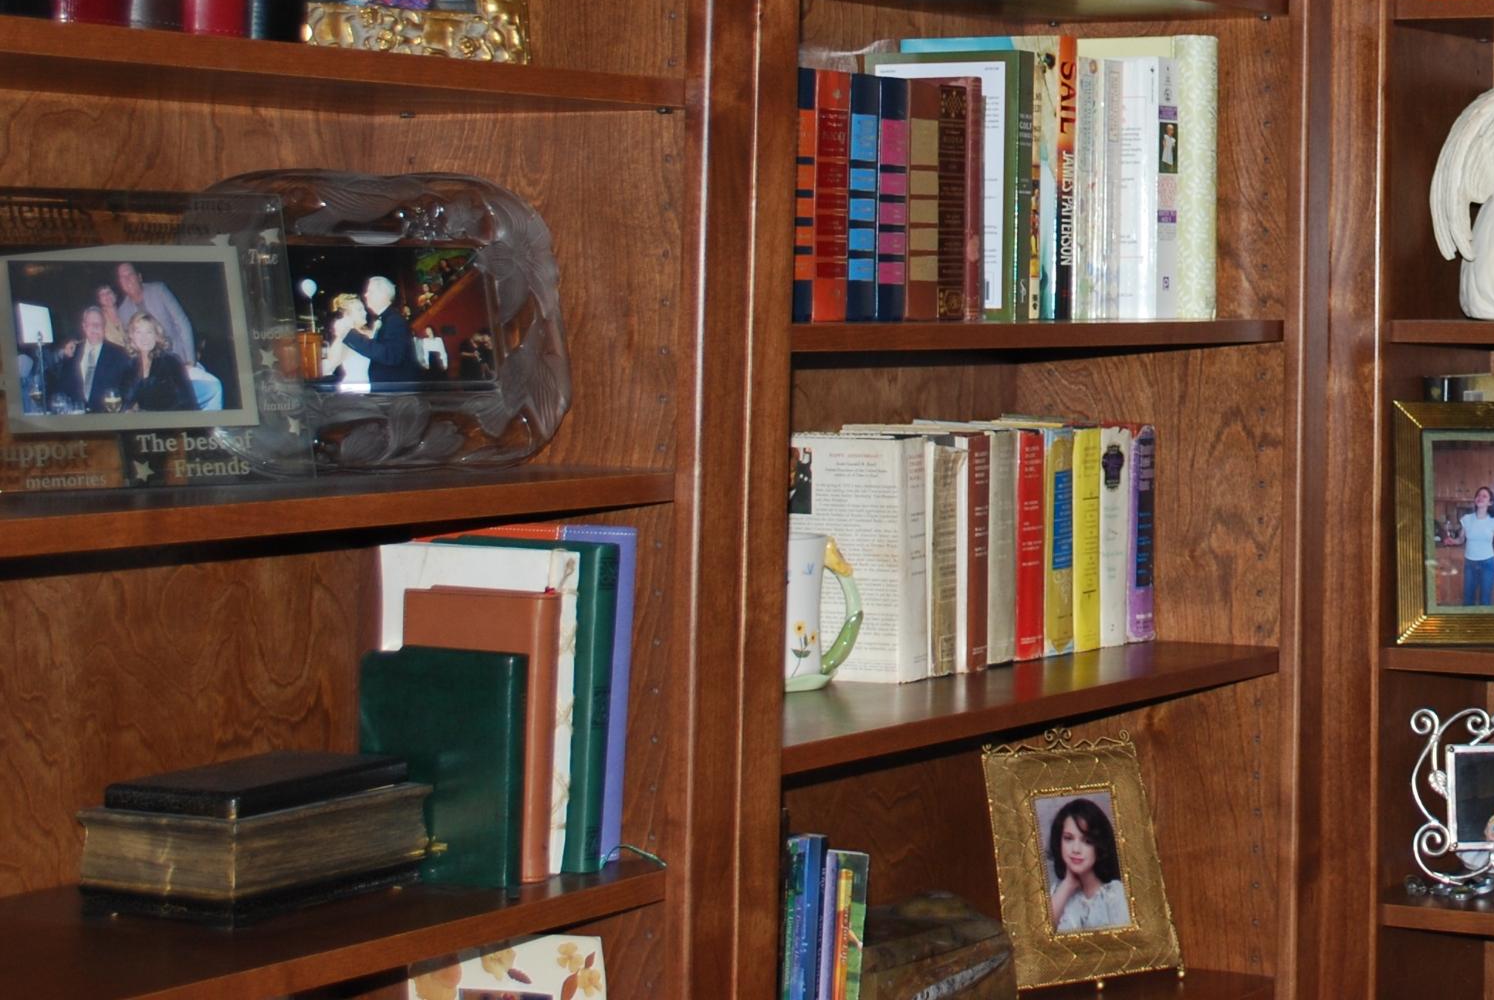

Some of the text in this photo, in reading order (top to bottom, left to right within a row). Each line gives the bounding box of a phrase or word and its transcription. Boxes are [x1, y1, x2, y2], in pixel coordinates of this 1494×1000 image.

[1060, 61, 1077, 134] SAIL
[1060, 151, 1074, 267] JAMES PATTERSON
[137, 433, 176, 453] The
[175, 458, 250, 478] Friends
[26, 473, 107, 490] memories
